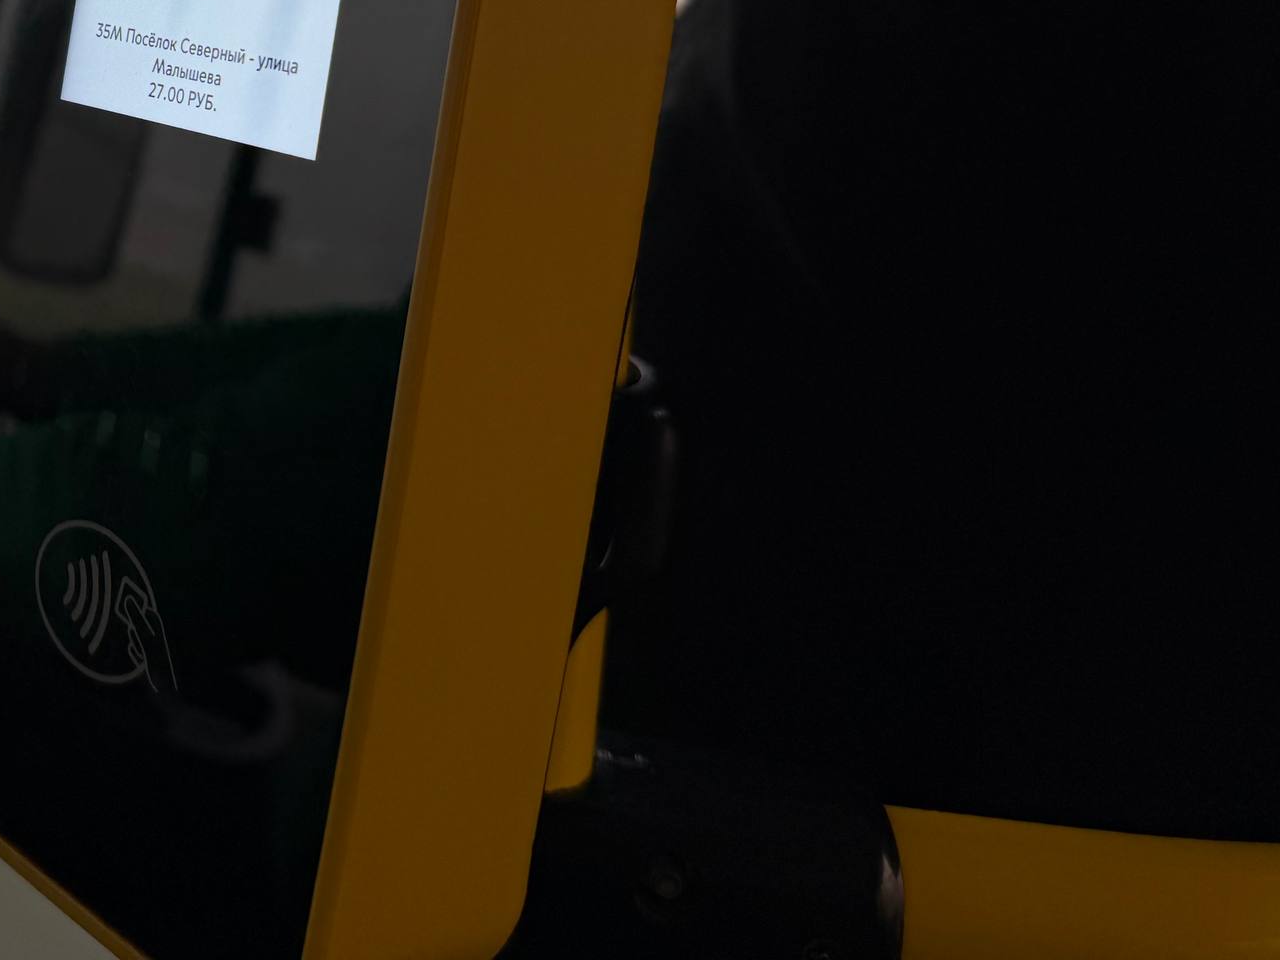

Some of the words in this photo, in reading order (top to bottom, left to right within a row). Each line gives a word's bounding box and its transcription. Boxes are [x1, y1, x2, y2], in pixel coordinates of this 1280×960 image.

[95, 22, 122, 41] 35М
[125, 28, 177, 52] Посёлок
[180, 38, 246, 65] Северный
[256, 54, 299, 75] улица
[151, 58, 222, 86] Малышева
[147, 82, 185, 104] 27.00
[187, 90, 217, 112] РУБ.
